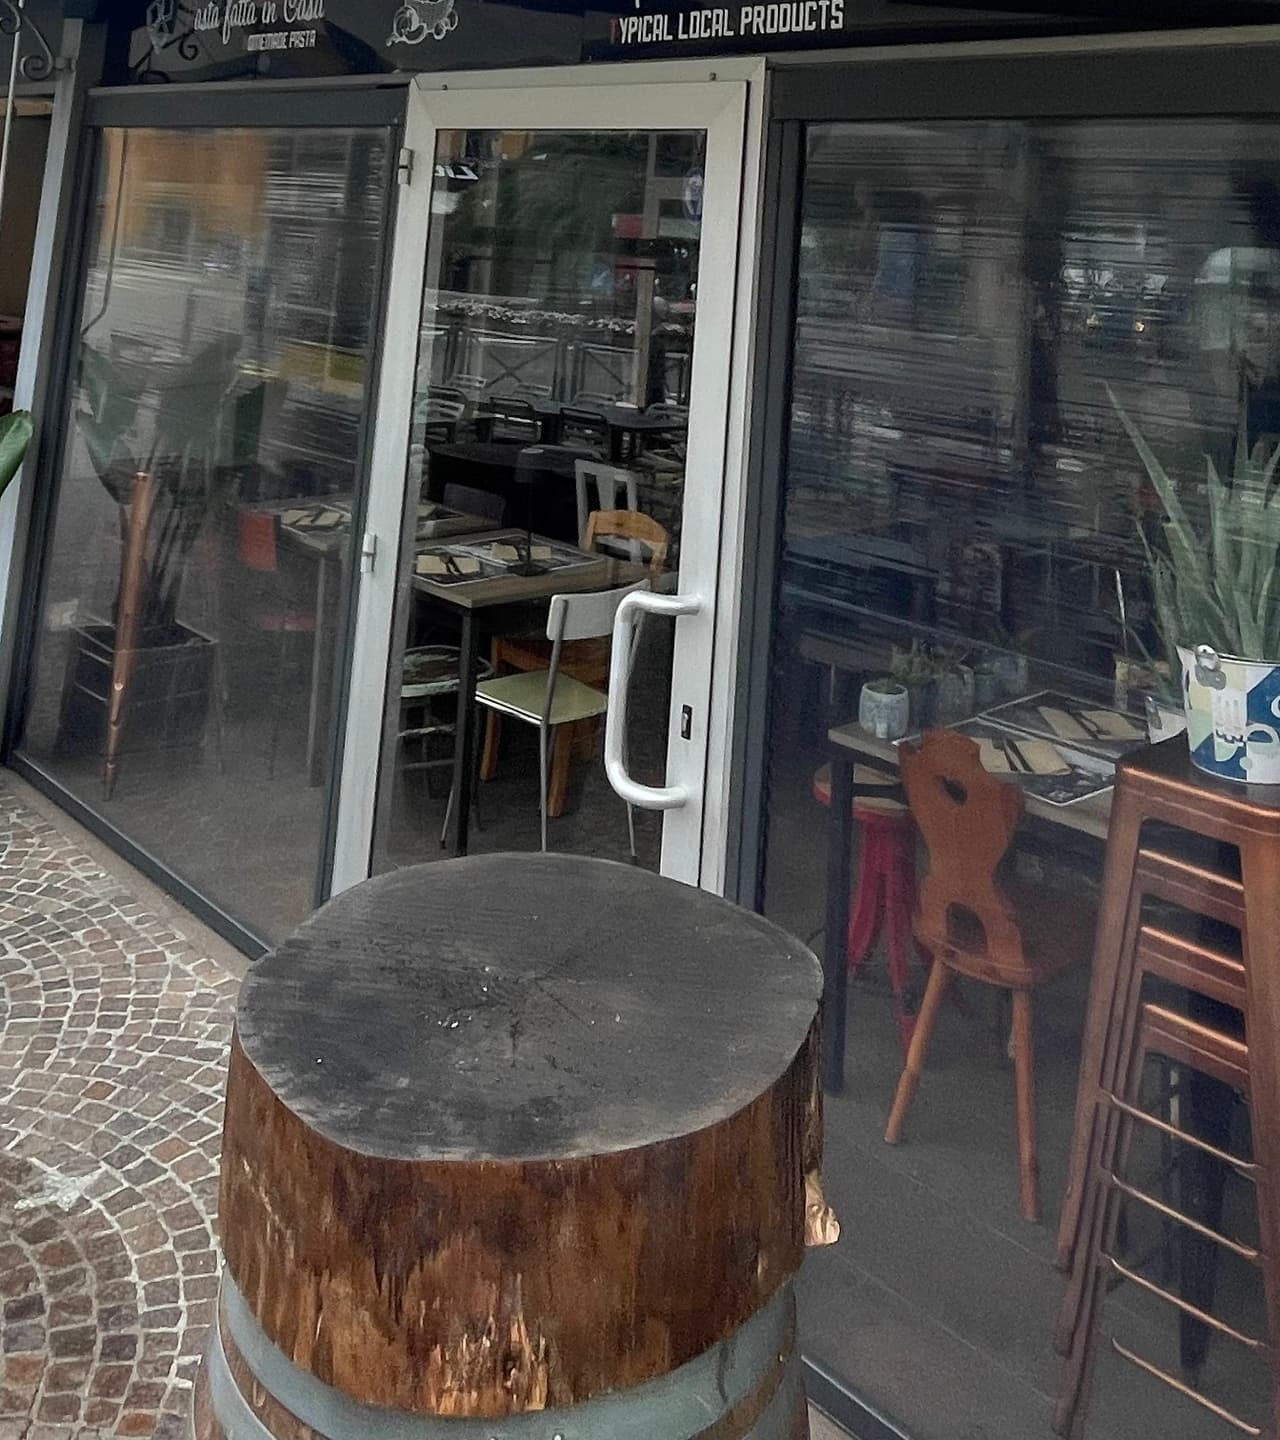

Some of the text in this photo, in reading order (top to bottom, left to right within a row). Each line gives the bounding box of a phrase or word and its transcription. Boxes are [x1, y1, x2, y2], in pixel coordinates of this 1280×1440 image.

[288, 29, 317, 49] PASTA
[609, 12, 673, 45] TYPICAL
[678, 8, 734, 41] LOCAL
